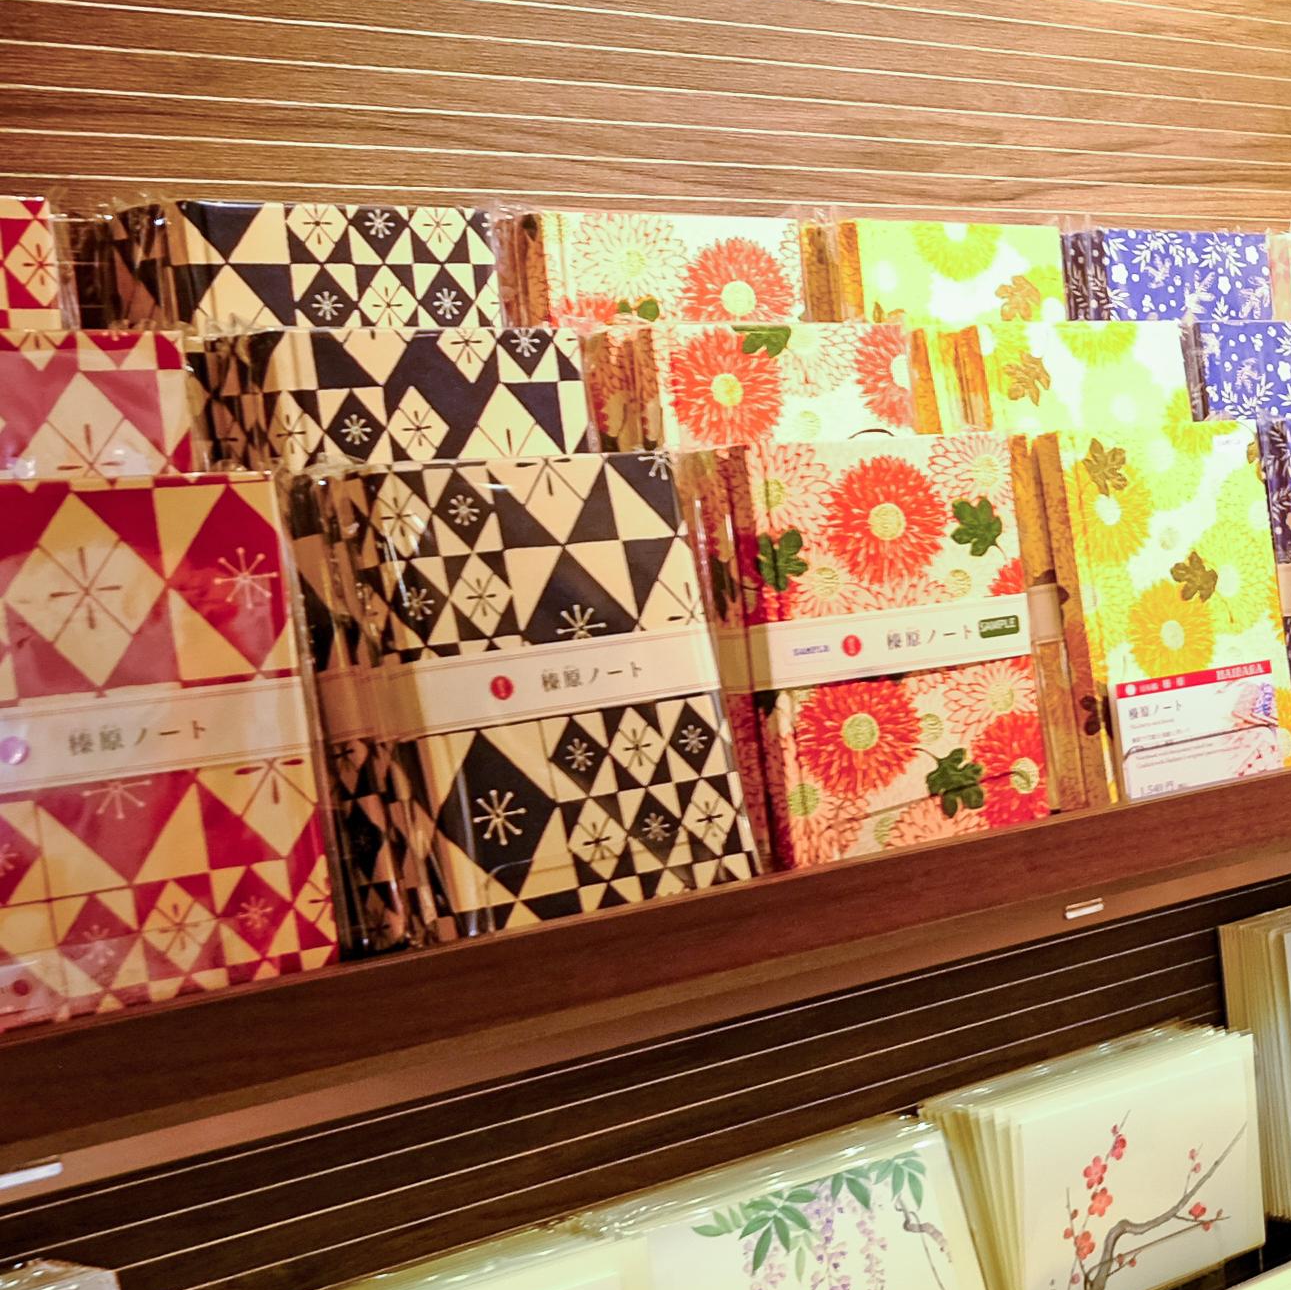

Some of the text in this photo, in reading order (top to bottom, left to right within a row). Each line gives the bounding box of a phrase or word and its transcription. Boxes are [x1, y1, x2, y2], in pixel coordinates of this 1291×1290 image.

[540, 660, 643, 693] 榛原ノート
[69, 721, 206, 756] 榛原ノート
